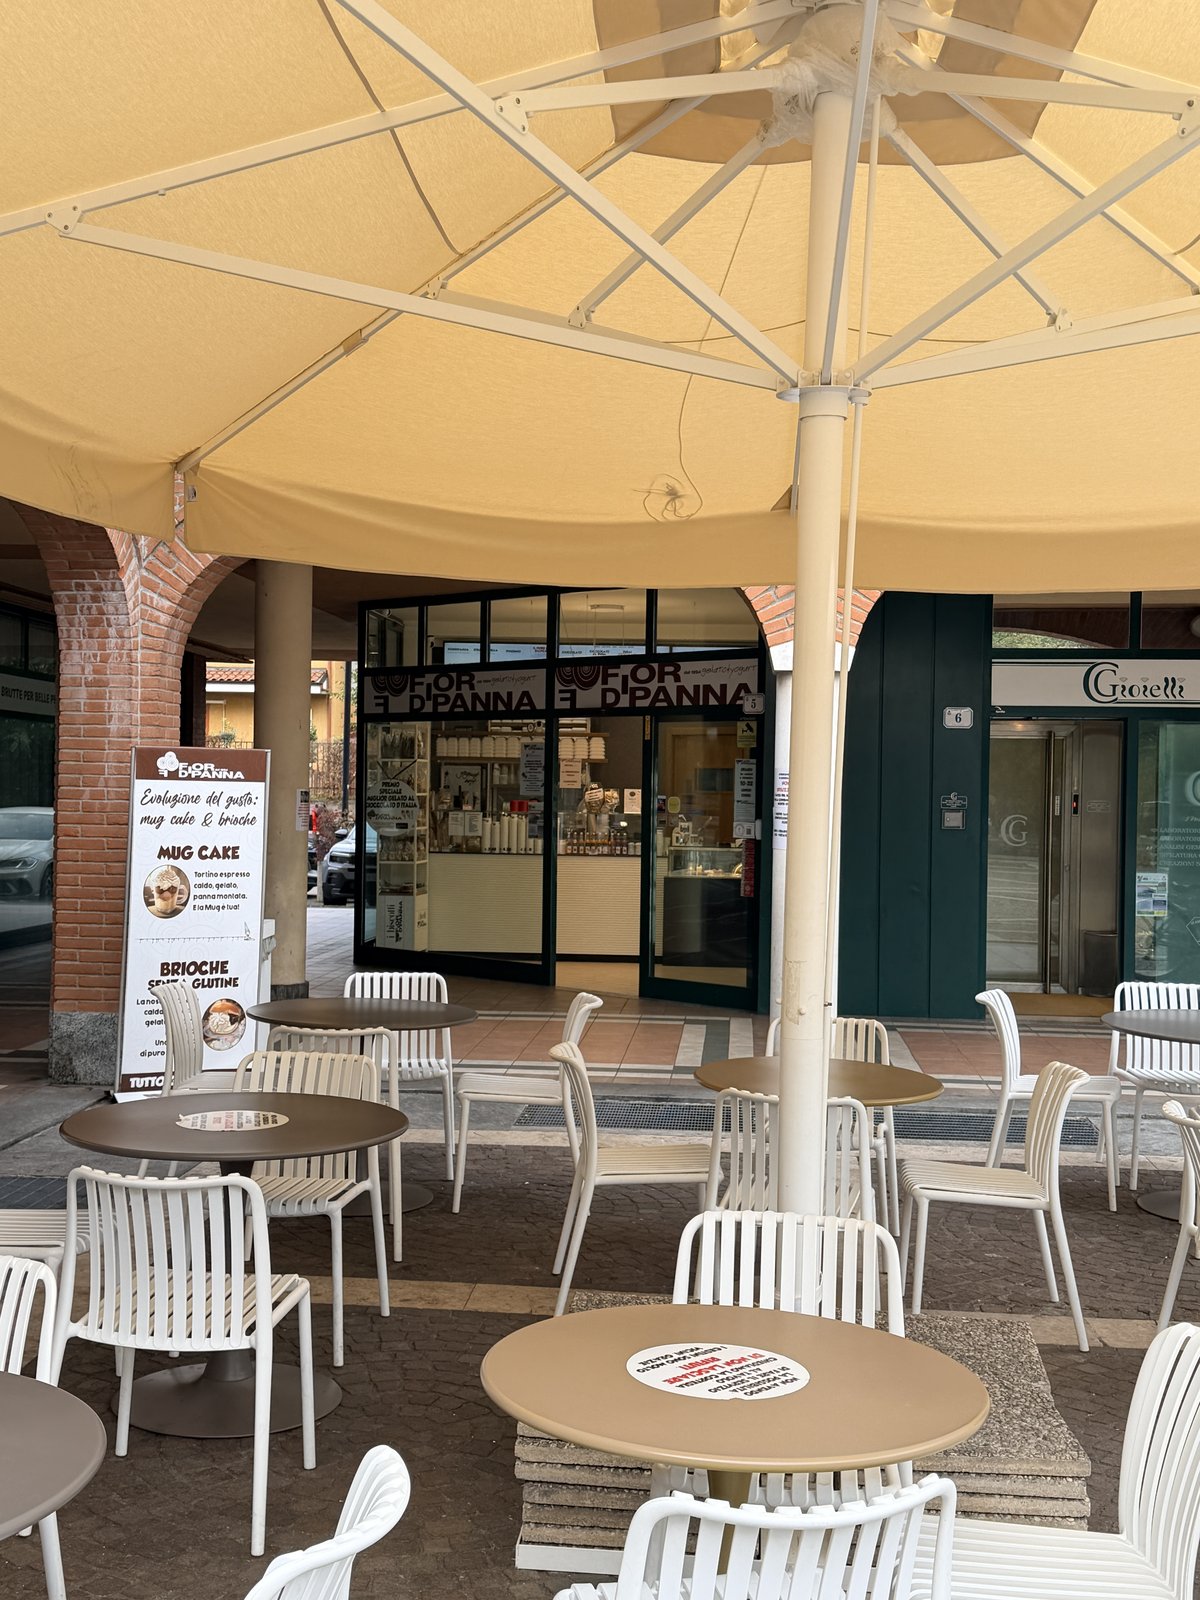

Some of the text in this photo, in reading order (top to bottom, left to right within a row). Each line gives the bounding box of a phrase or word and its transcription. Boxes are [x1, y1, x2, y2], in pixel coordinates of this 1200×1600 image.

[24, 690, 34, 701] PER
[751, 698, 756, 708] 5
[955, 713, 962, 723] 6
[140, 788, 258, 809] Evoluzione del gusto:
[140, 811, 257, 829] mug cake & brioche
[157, 845, 240, 860] MUG CAKE
[205, 904, 220, 912] Mug
[160, 961, 229, 976] BRIOCHE
[192, 977, 239, 989] GLUTINE
[666, 1356, 691, 1364] SONO
[722, 1356, 752, 1366] NON
[730, 1357, 778, 1372] CHIEDIAMO
[636, 1362, 666, 1373] MOLTO
[756, 1369, 780, 1378] FARE
[662, 1364, 725, 1384] LASCIARE
[716, 1371, 751, 1383] TAVOLO
[675, 1374, 719, 1388] CORTESIA
[708, 1379, 750, 1393] SERVIZIO
[743, 1377, 799, 1396] NON AVENDO
